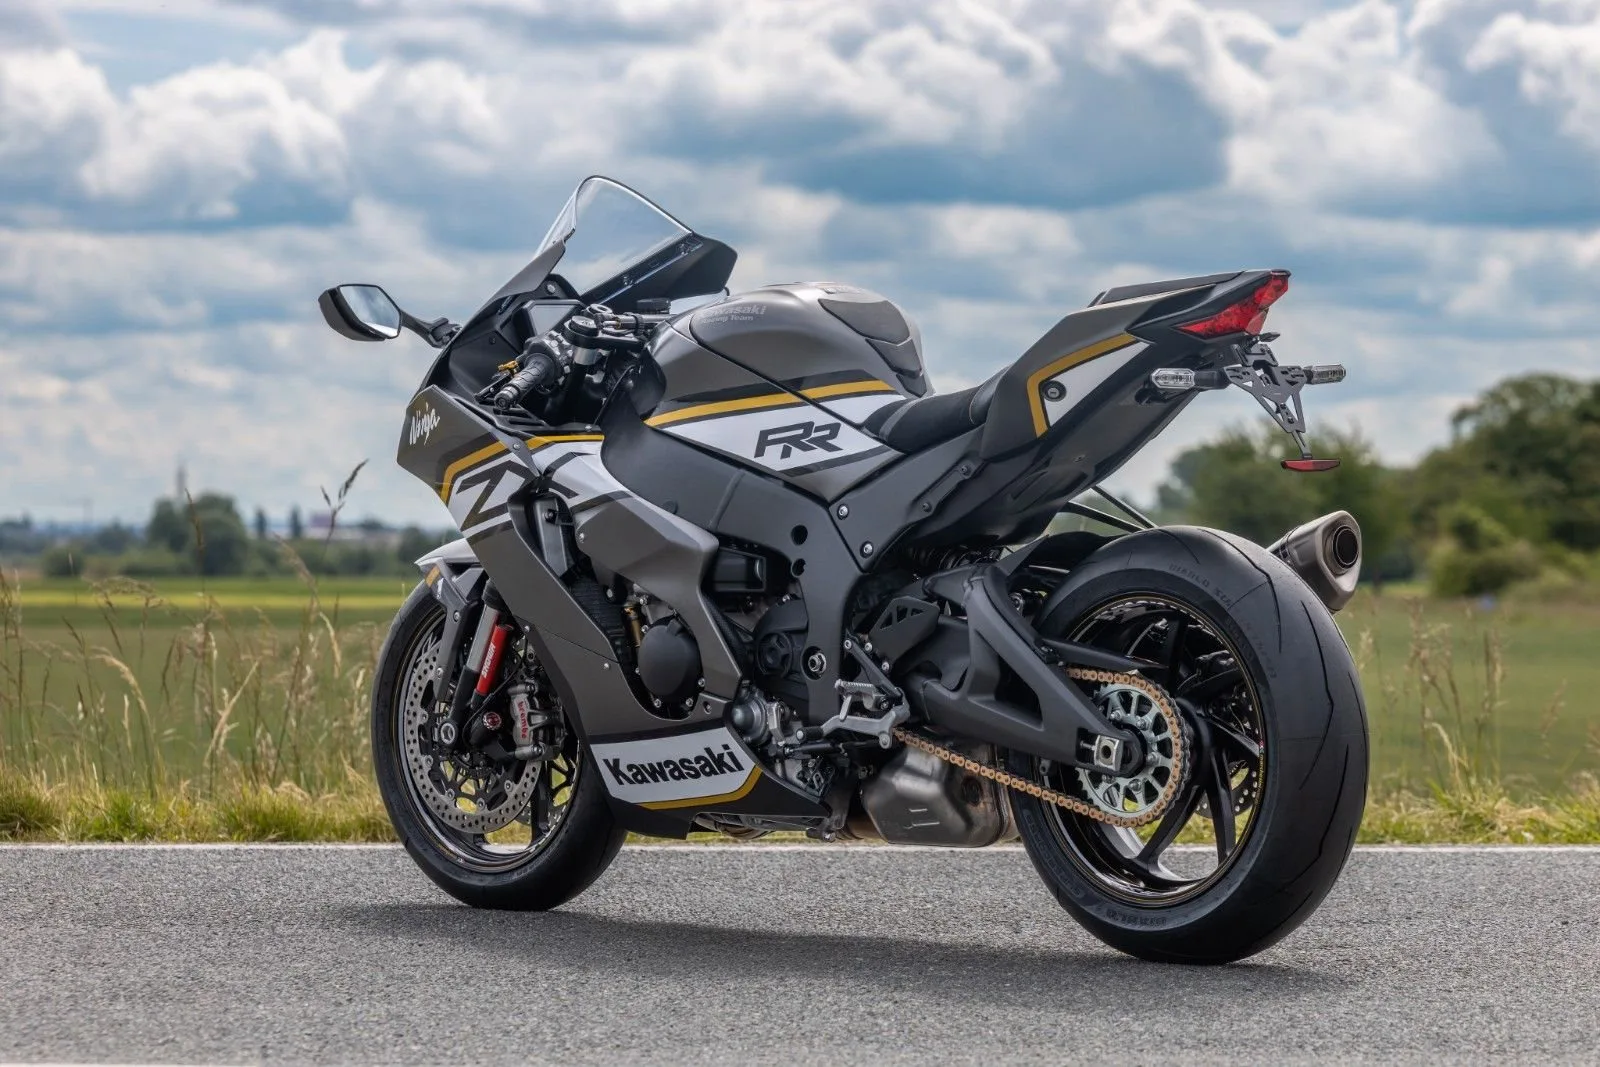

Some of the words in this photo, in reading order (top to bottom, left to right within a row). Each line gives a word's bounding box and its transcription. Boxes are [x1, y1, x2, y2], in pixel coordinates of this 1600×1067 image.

[409, 402, 441, 446] Ninja
[481, 642, 496, 678] SHOWA
[602, 744, 744, 786] Kawasaki
